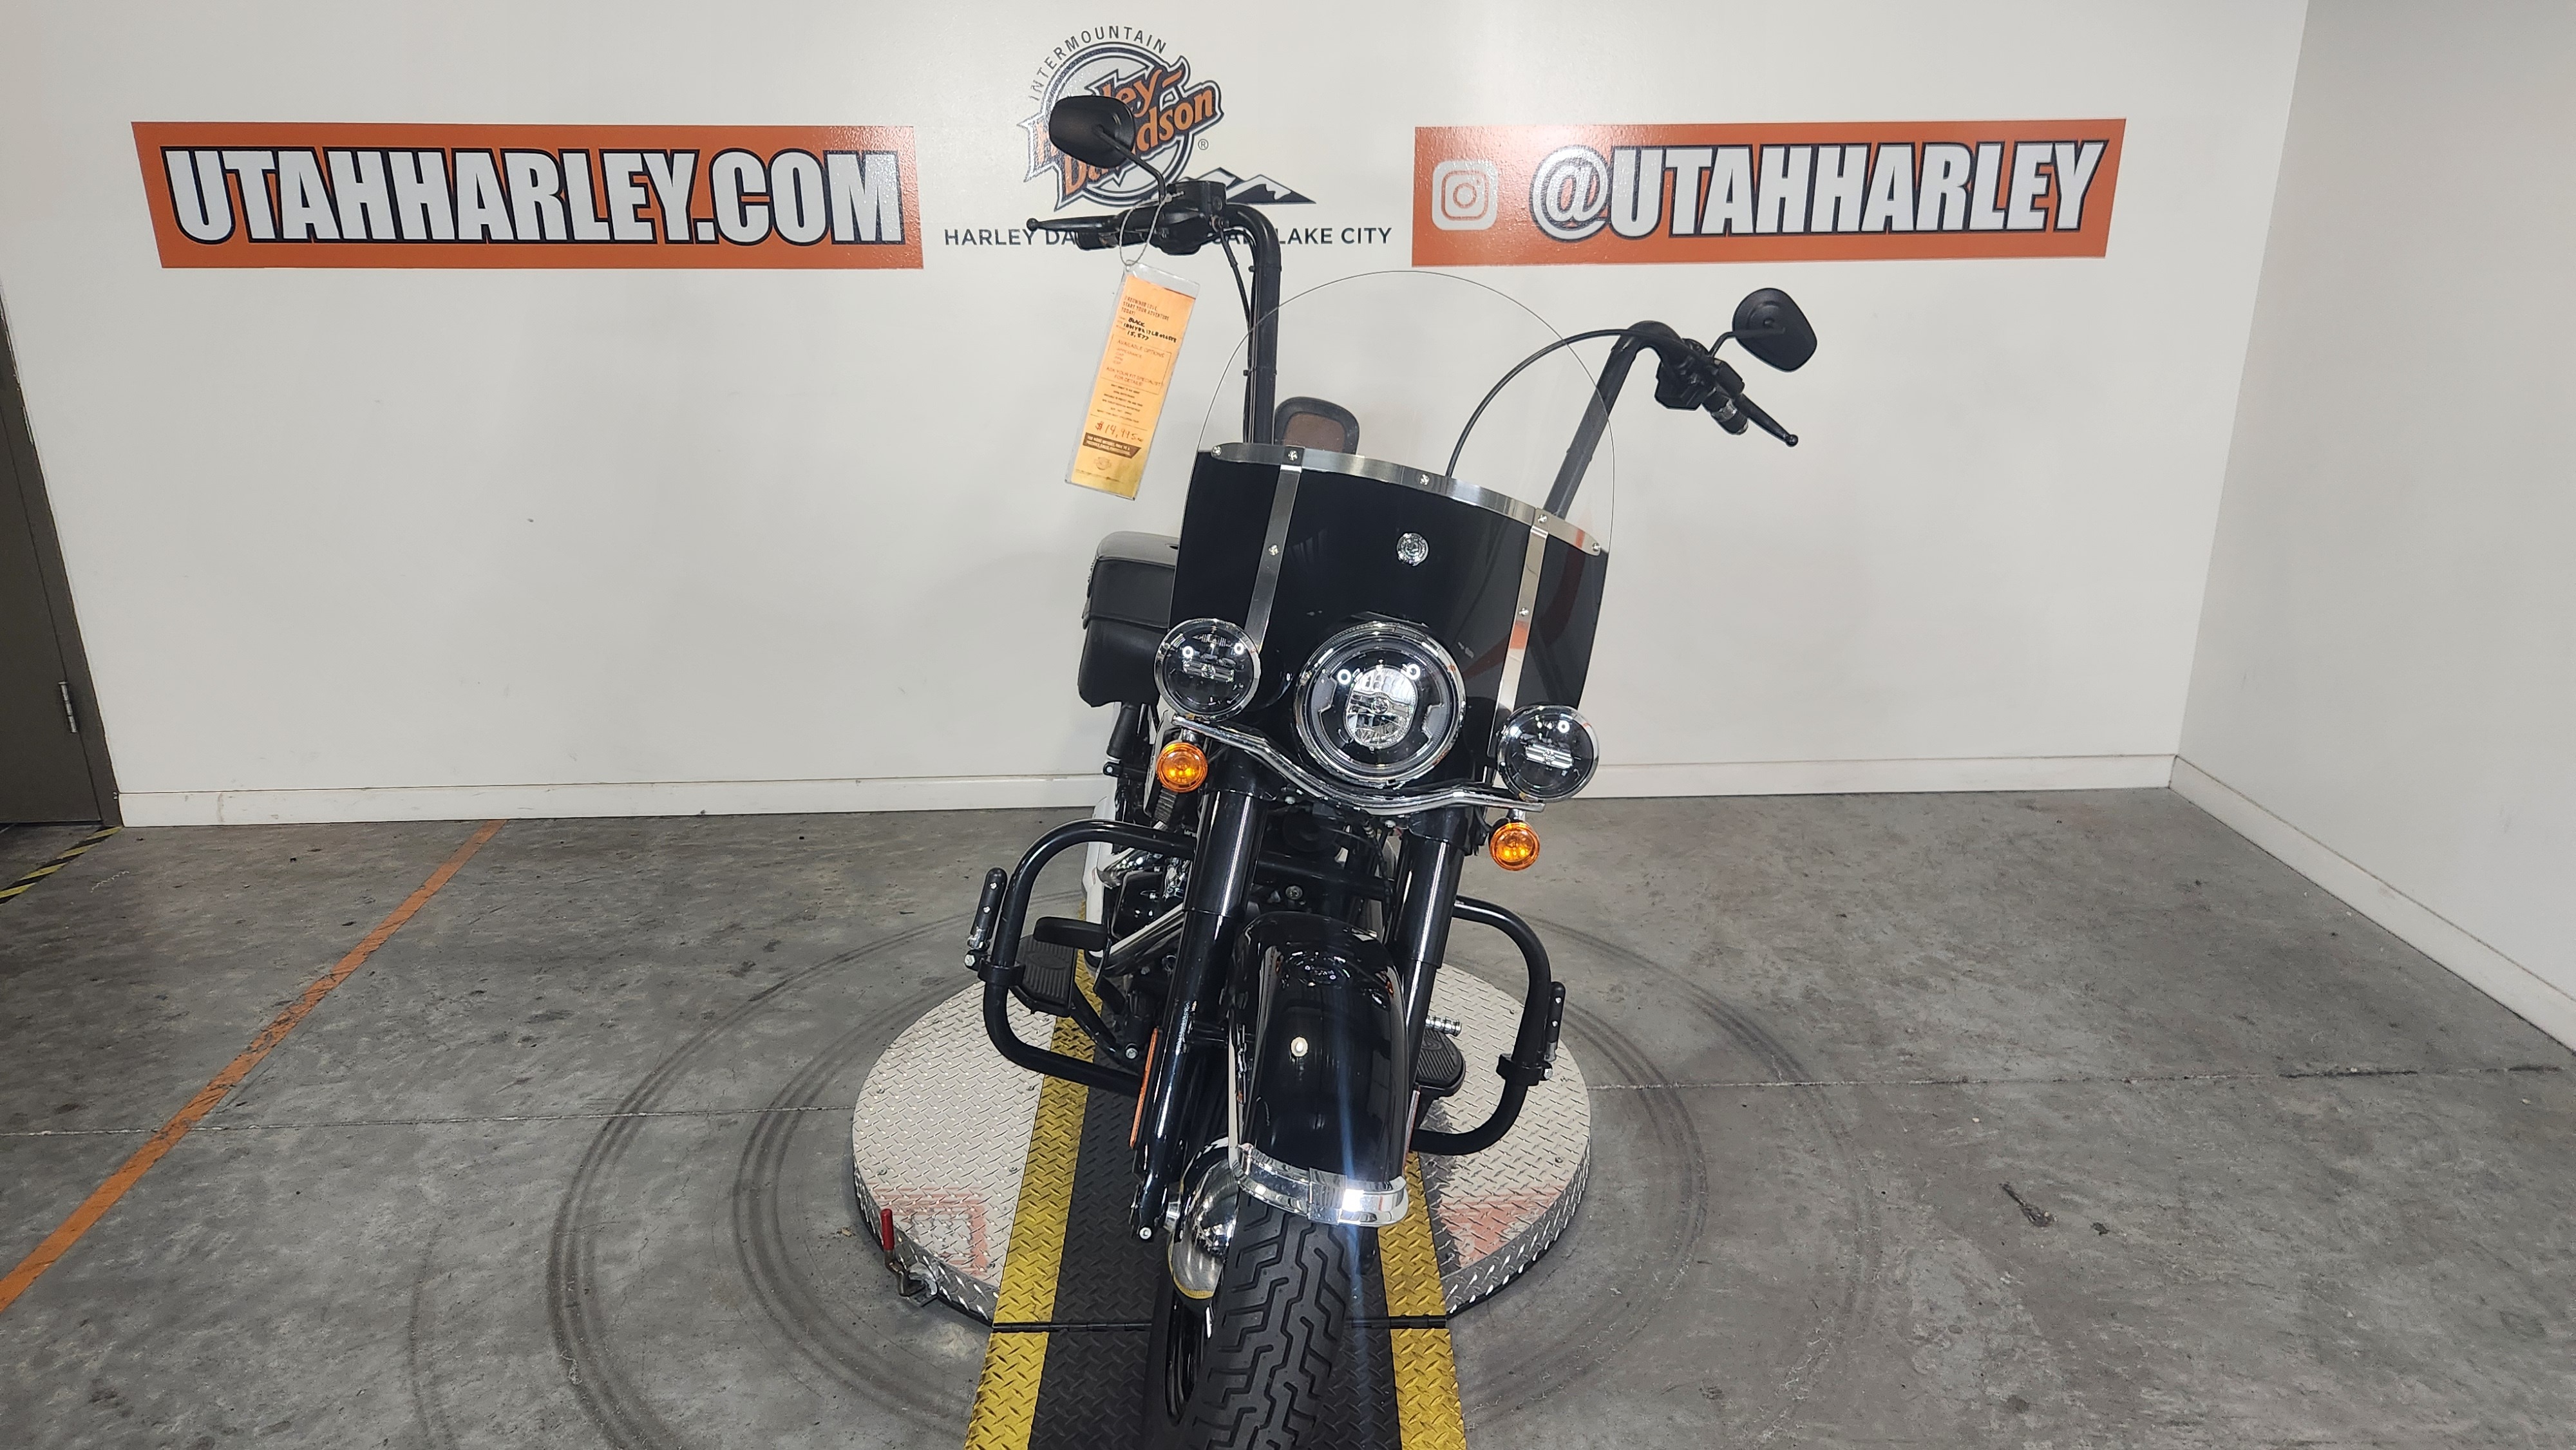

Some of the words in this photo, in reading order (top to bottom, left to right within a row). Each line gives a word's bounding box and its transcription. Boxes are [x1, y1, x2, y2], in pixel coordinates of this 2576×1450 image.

[1029, 25, 1167, 102] INTERMOUNTAIN
[160, 146, 906, 245] UTAHHARLEY.COM
[1530, 139, 2108, 241] @UTAHHARLEY
[944, 229, 1034, 246] HARLEY
[1341, 227, 1392, 245] CITY
[1127, 330, 1149, 341] 15,577
[1128, 317, 1145, 326] BLACK
